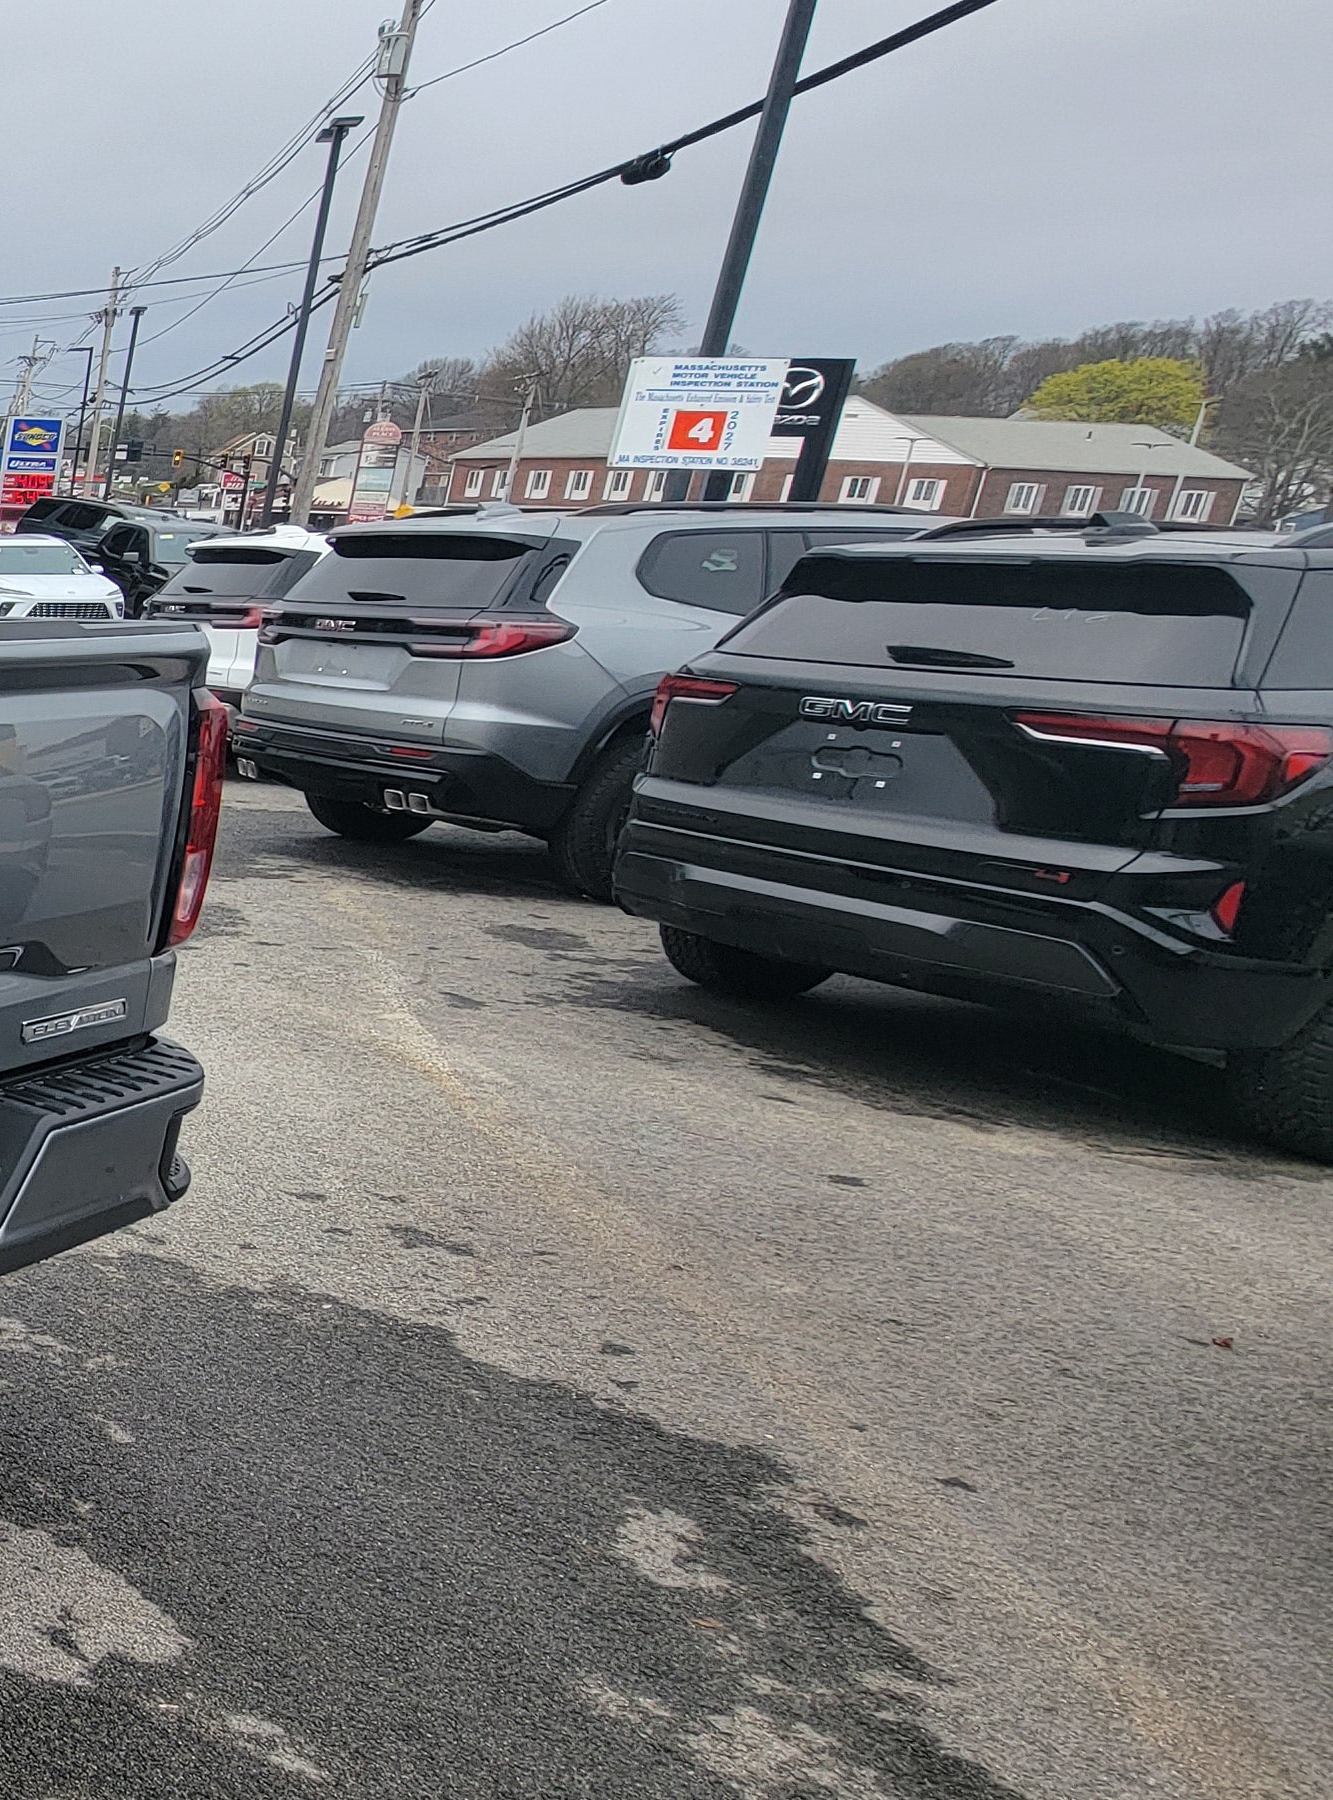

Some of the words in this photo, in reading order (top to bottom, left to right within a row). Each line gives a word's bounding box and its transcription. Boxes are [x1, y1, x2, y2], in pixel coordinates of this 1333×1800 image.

[674, 364, 767, 372] MASSACHUSETTS
[670, 380, 731, 388] INSPECTION
[687, 417, 715, 443] 4
[15, 432, 56, 440] SUNOCO
[633, 455, 678, 464] INSPECTION
[797, 696, 913, 726] GMC
[32, 1004, 123, 1036] ELEVATION
